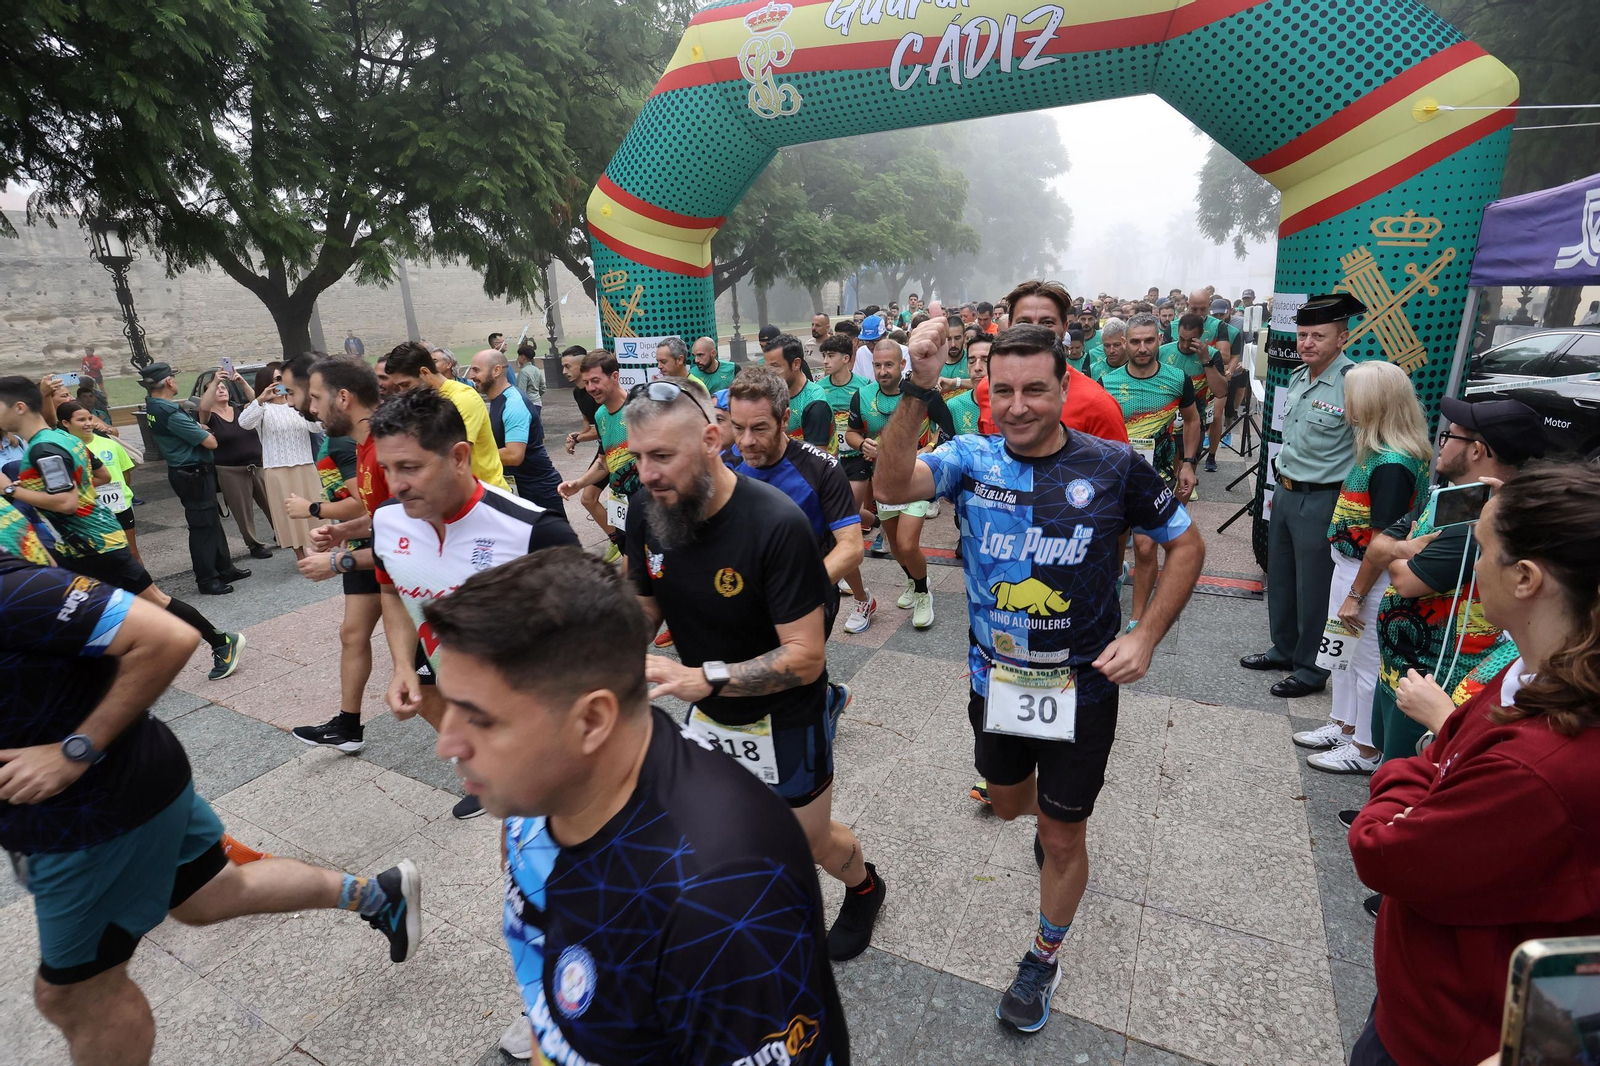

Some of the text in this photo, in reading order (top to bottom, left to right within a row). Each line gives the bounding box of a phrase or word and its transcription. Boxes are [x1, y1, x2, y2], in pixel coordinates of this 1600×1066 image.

[889, 4, 1065, 91] CÁDIZ
[1284, 348, 1301, 358] Caix
[1544, 416, 1572, 428] Motor
[1073, 524, 1094, 539] CLUB
[990, 610, 1071, 630] RINO ALQUILERES
[1002, 664, 1034, 676] CARRERA
[1017, 694, 1058, 724] 30
